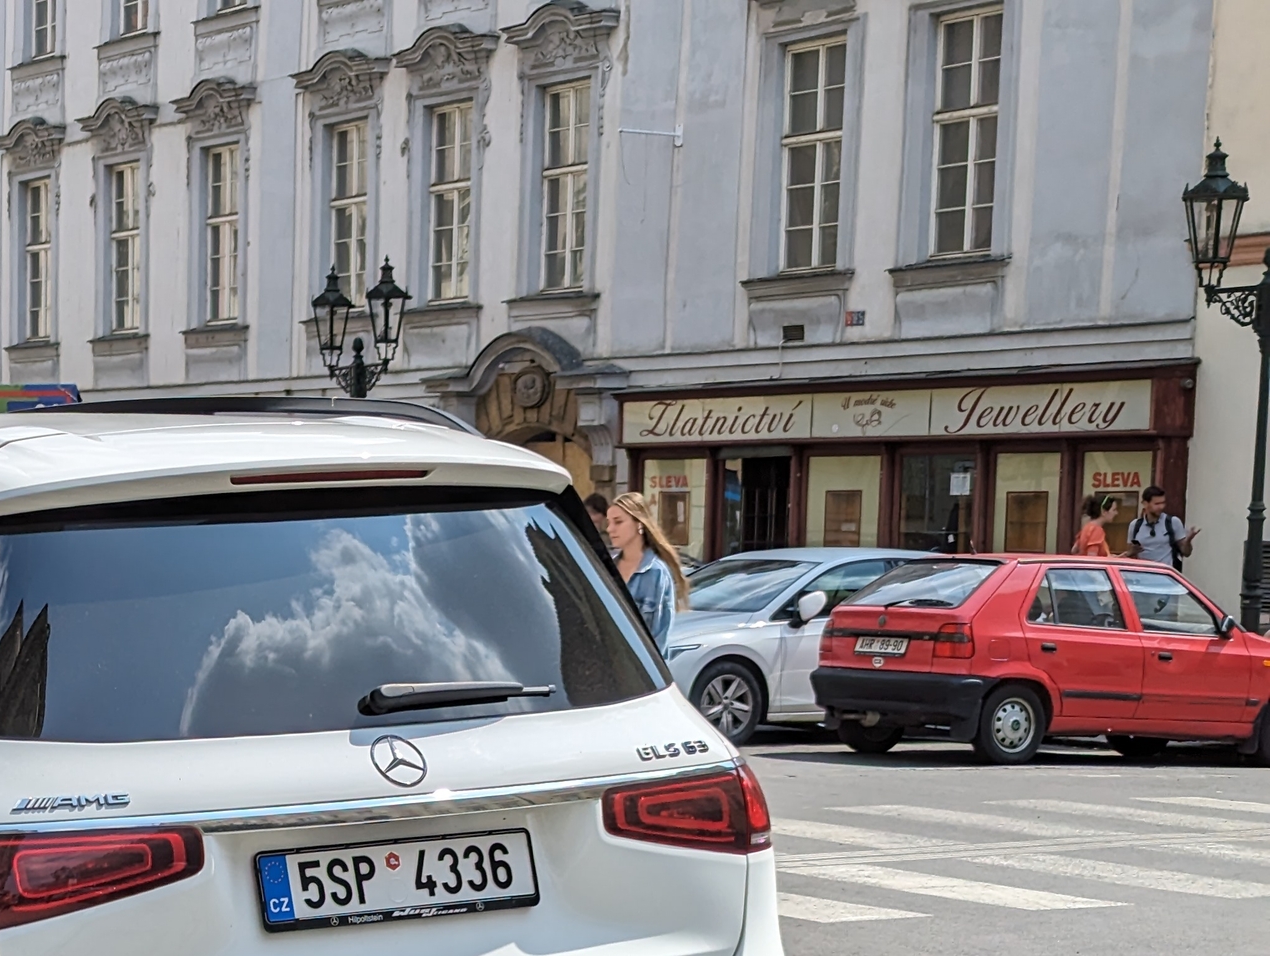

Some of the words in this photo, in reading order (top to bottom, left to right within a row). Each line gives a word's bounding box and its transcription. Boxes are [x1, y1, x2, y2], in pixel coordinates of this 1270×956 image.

[639, 399, 804, 437] Zlatnictví
[944, 386, 1126, 434] Jewellery
[649, 474, 689, 489] SLEVA
[1091, 471, 1142, 489] SLEVA
[878, 638, 904, 652] 89-90
[636, 742, 681, 762] GLS
[681, 740, 710, 756] 63
[50, 793, 131, 813] AMG
[297, 855, 376, 909] 5SP
[414, 842, 513, 897] 4336
[269, 897, 291, 913] CZ
